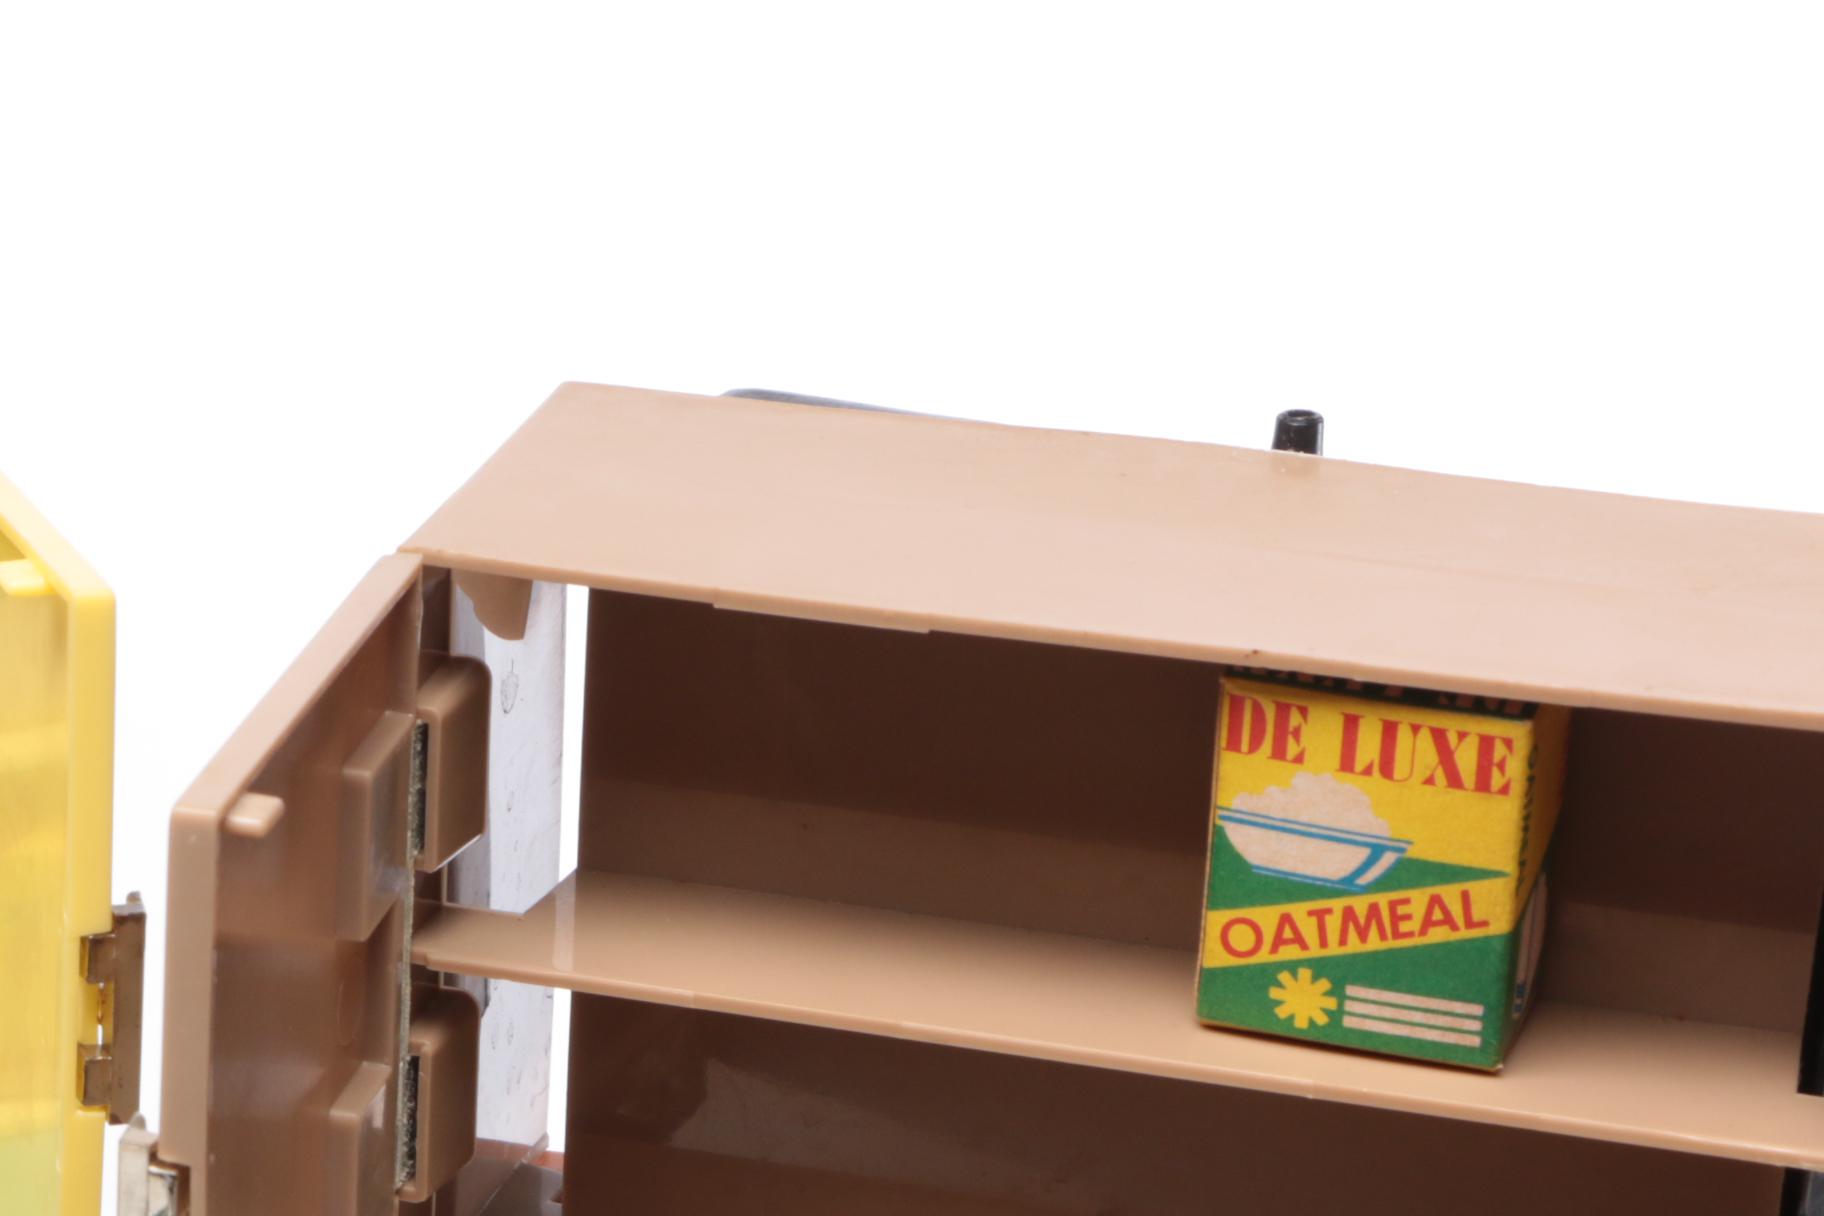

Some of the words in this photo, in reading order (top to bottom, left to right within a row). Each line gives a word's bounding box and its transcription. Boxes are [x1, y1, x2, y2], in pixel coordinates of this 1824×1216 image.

[1222, 693, 1309, 765] DE
[1335, 711, 1514, 796] LUXE
[1220, 889, 1490, 959] OATMEAL
